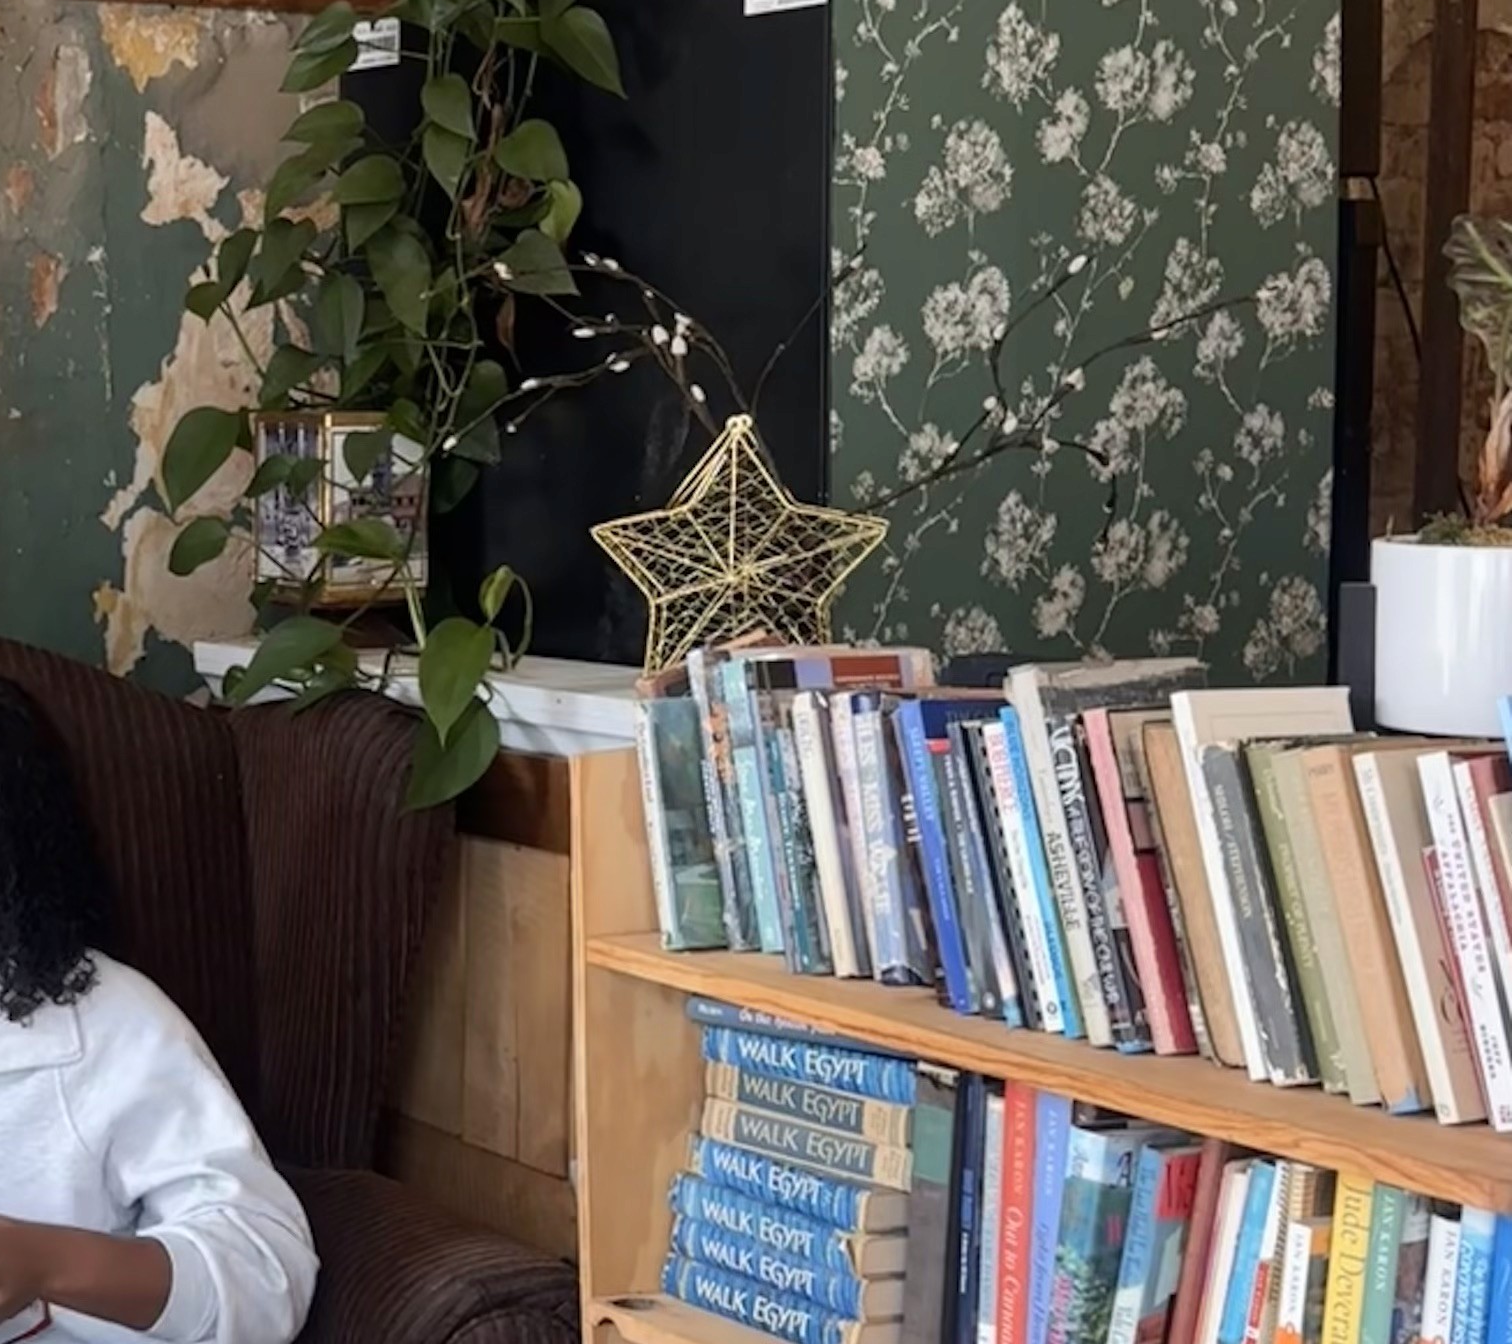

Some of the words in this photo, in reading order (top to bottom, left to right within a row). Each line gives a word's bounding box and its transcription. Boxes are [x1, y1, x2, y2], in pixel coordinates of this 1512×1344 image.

[1043, 829, 1083, 933] ASHEVILLE
[1440, 849, 1469, 952] APPALACHIA
[1450, 839, 1473, 905] UNITED
[1464, 908, 1488, 975] STATES
[1288, 898, 1304, 920] OF
[1292, 920, 1316, 969] PLENTY
[738, 1038, 796, 1071] WALK
[804, 1050, 870, 1085] EGYPT
[742, 1074, 797, 1108] WALK
[802, 1089, 861, 1126] EGYPT
[1011, 1100, 1027, 1132] JAN
[1046, 1108, 1060, 1135] JAN
[740, 1116, 799, 1152] WALK
[807, 1132, 870, 1170] EGYPT
[1009, 1136, 1026, 1194] KARON
[1041, 1141, 1058, 1195] KARON
[713, 1146, 763, 1184] WALK
[768, 1166, 823, 1204] EGYPT
[701, 1197, 753, 1234] WALK
[759, 1216, 815, 1256] EGYPT
[1002, 1205, 1025, 1243] Out
[1334, 1181, 1376, 1246] Jude
[1378, 1193, 1397, 1227] JAN
[701, 1236, 754, 1274] WALK
[759, 1255, 816, 1296] EGYPT
[1003, 1247, 1019, 1268] to
[1370, 1229, 1394, 1293] KARON
[1442, 1229, 1457, 1263] JAN
[695, 1274, 748, 1314] WALK
[752, 1295, 810, 1338] EGYPT
[1286, 1263, 1302, 1314] KARON
[1434, 1267, 1453, 1326] KARON
